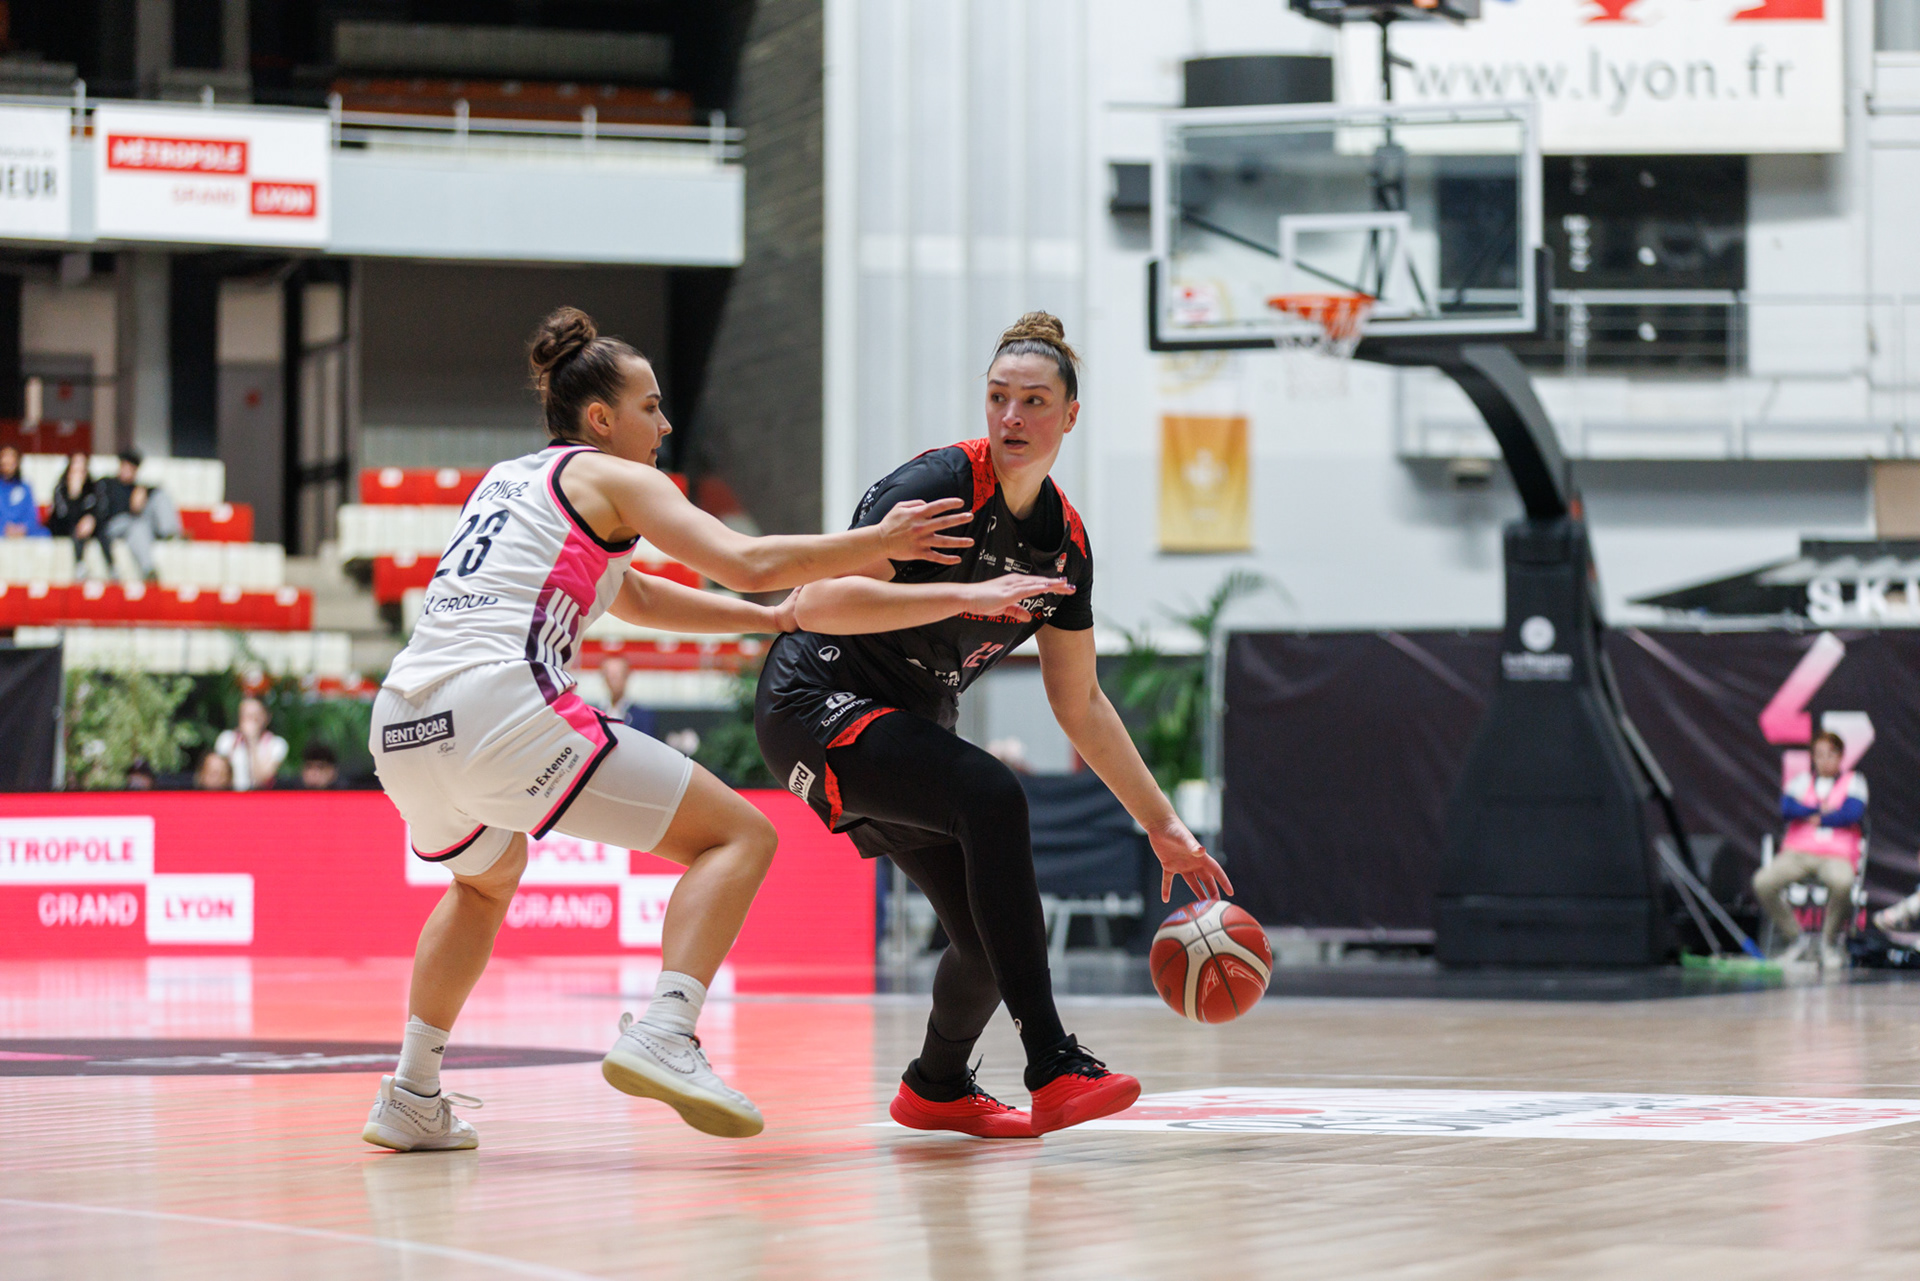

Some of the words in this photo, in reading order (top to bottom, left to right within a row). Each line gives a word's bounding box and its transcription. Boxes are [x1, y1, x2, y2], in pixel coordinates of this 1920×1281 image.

[1411, 44, 1793, 115] www.lyon.fr
[434, 509, 510, 577] 23
[385, 727, 415, 744] RENT
[525, 785, 540, 797] In
[535, 746, 573, 786] Extenso
[38, 892, 138, 927] GRAND
[163, 895, 236, 921] LYON
[504, 893, 613, 929] GRAND
